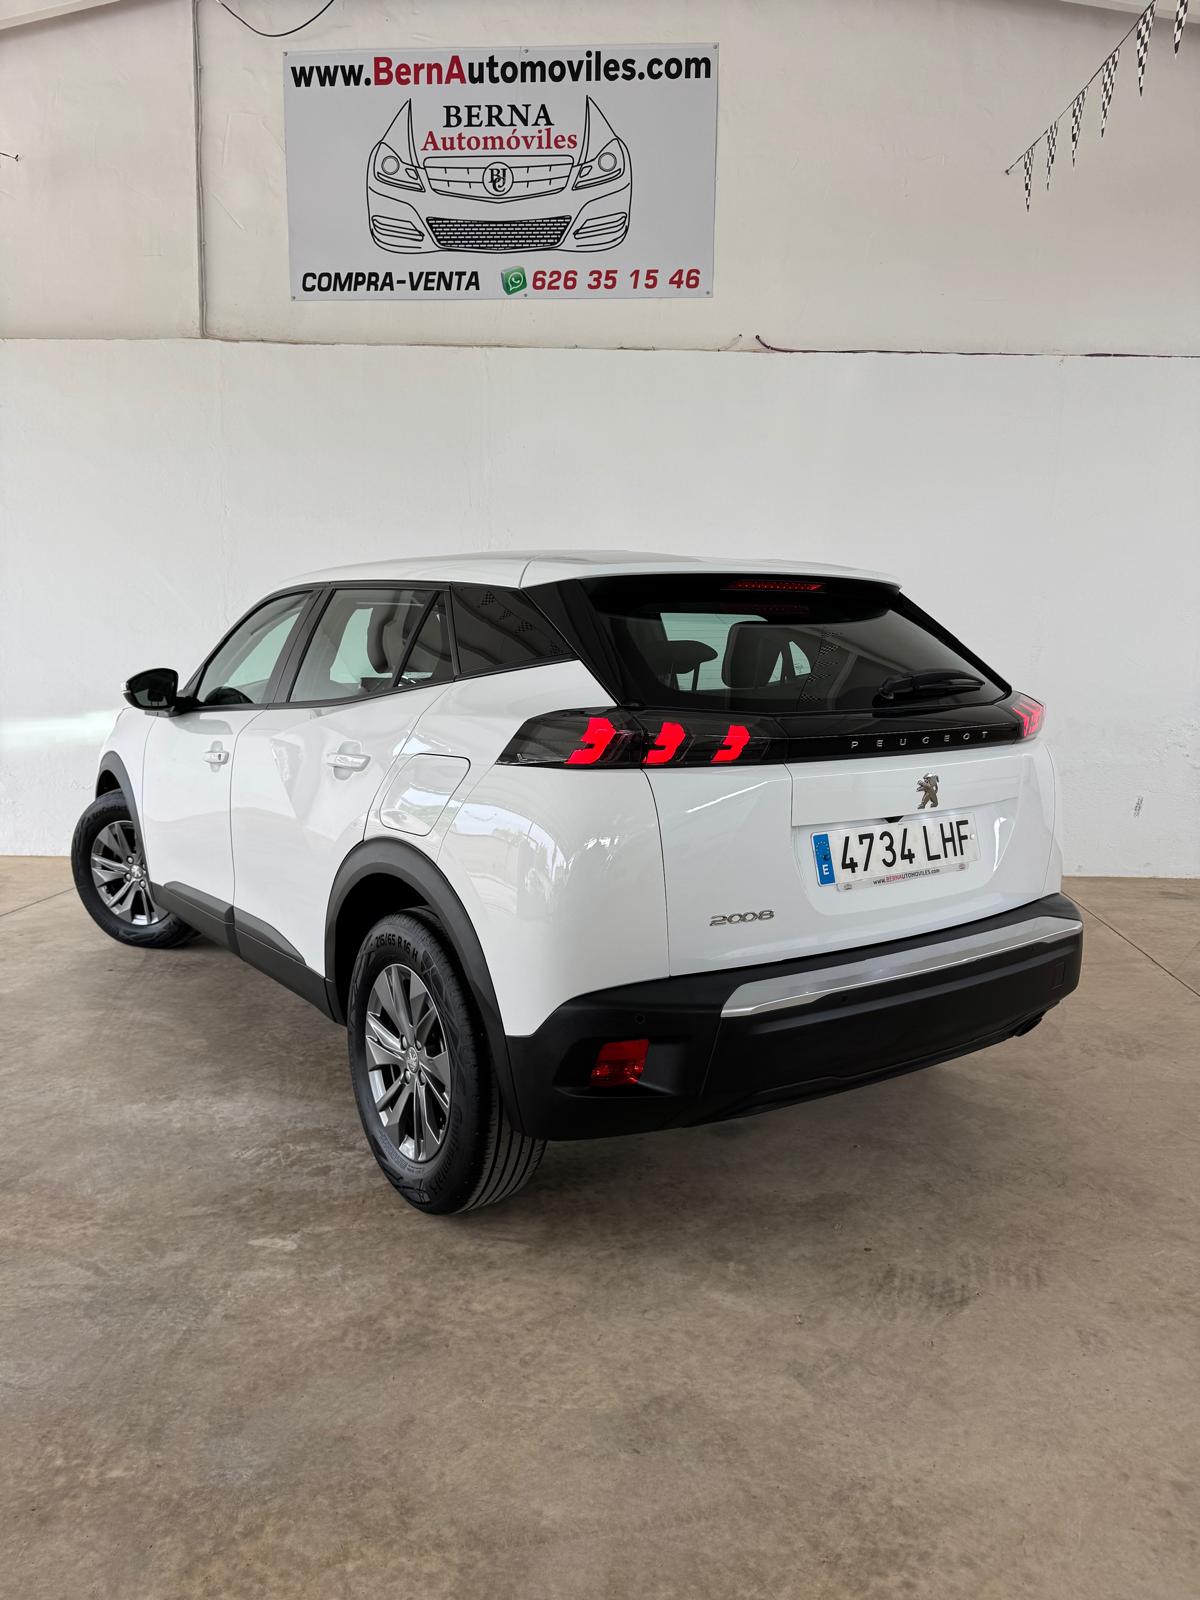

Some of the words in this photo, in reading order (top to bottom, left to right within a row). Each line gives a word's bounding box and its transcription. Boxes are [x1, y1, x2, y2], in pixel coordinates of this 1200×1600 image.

[291, 50, 711, 87] www.BernAutomoviles.com
[443, 104, 554, 128] BERNA
[421, 129, 577, 151] Automóviles
[302, 271, 480, 292] COMPRA-VENTA
[532, 269, 578, 290] 626
[587, 270, 618, 289] 35
[630, 270, 658, 289] 15
[669, 269, 701, 289] 46
[850, 730, 989, 749] PEUGEOT
[841, 828, 915, 873] 4734
[922, 819, 969, 861] LHF
[822, 864, 830, 875] E
[709, 910, 775, 926] 2008
